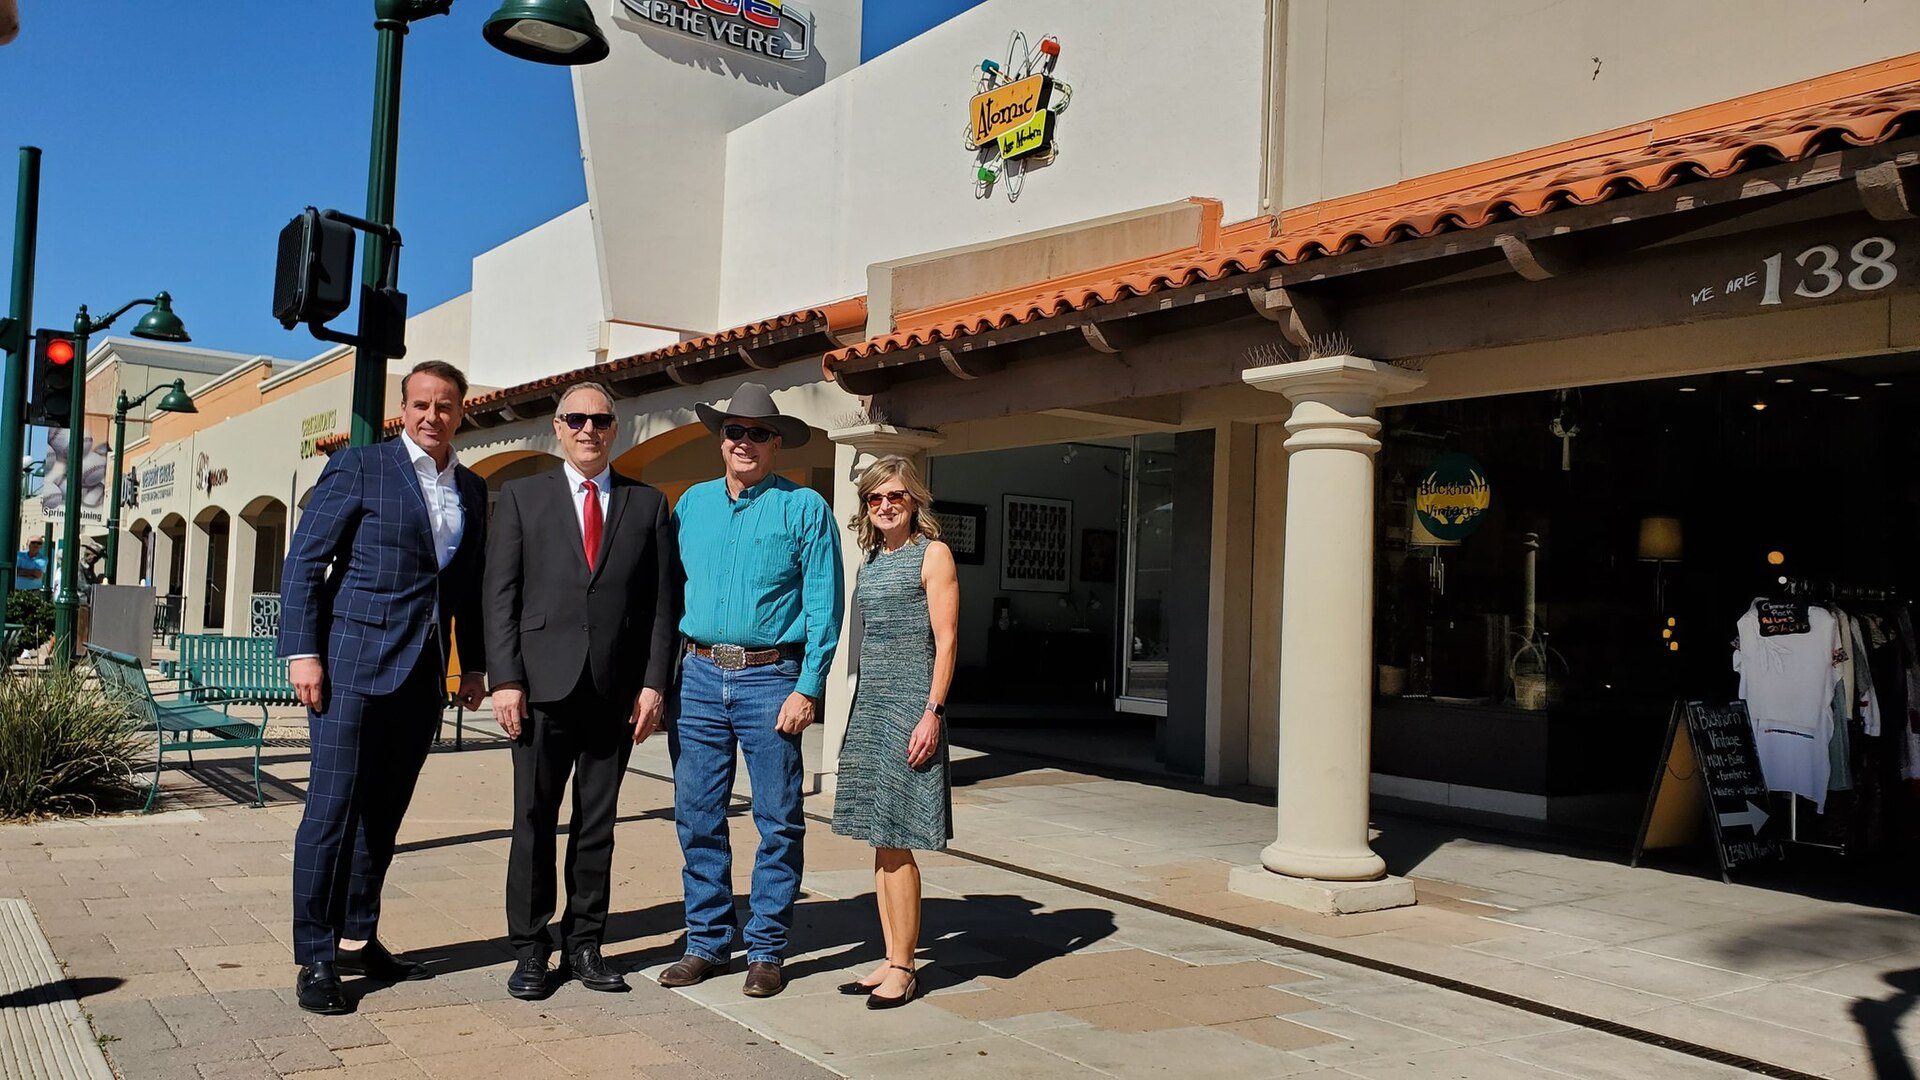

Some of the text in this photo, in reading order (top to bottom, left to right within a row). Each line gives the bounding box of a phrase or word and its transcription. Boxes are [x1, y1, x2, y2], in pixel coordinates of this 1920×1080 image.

[650, 0, 783, 57] CHEVERE
[976, 94, 1034, 141] Atomic
[1691, 236, 1898, 306] WE ARE 138
[1420, 481, 1488, 496] Buckhorn
[1426, 504, 1480, 520] Vintage
[253, 598, 281, 616] CBD
[1697, 707, 1741, 730] Buckhorn
[1708, 731, 1742, 754] Vintage
